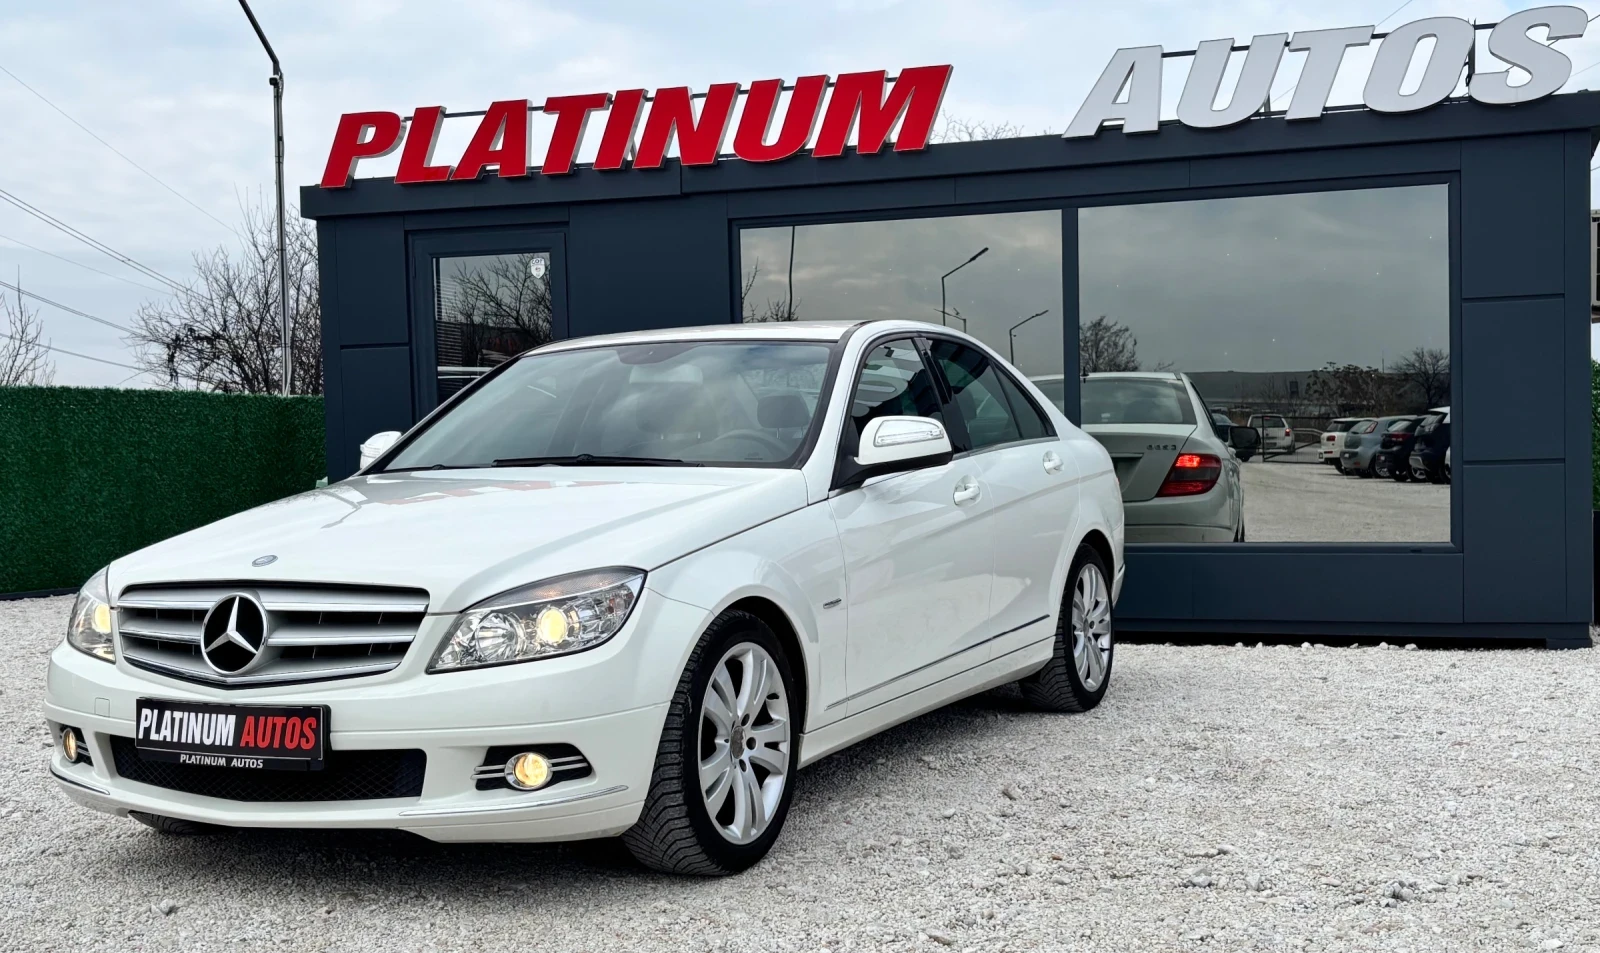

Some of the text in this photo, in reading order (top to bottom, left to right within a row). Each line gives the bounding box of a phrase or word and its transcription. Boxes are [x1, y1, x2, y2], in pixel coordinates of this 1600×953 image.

[320, 5, 1588, 188] PLATINUM AUTOS
[138, 708, 317, 750] PLATINUM AUTOS
[179, 753, 264, 769] PLATINUM AUTOS
